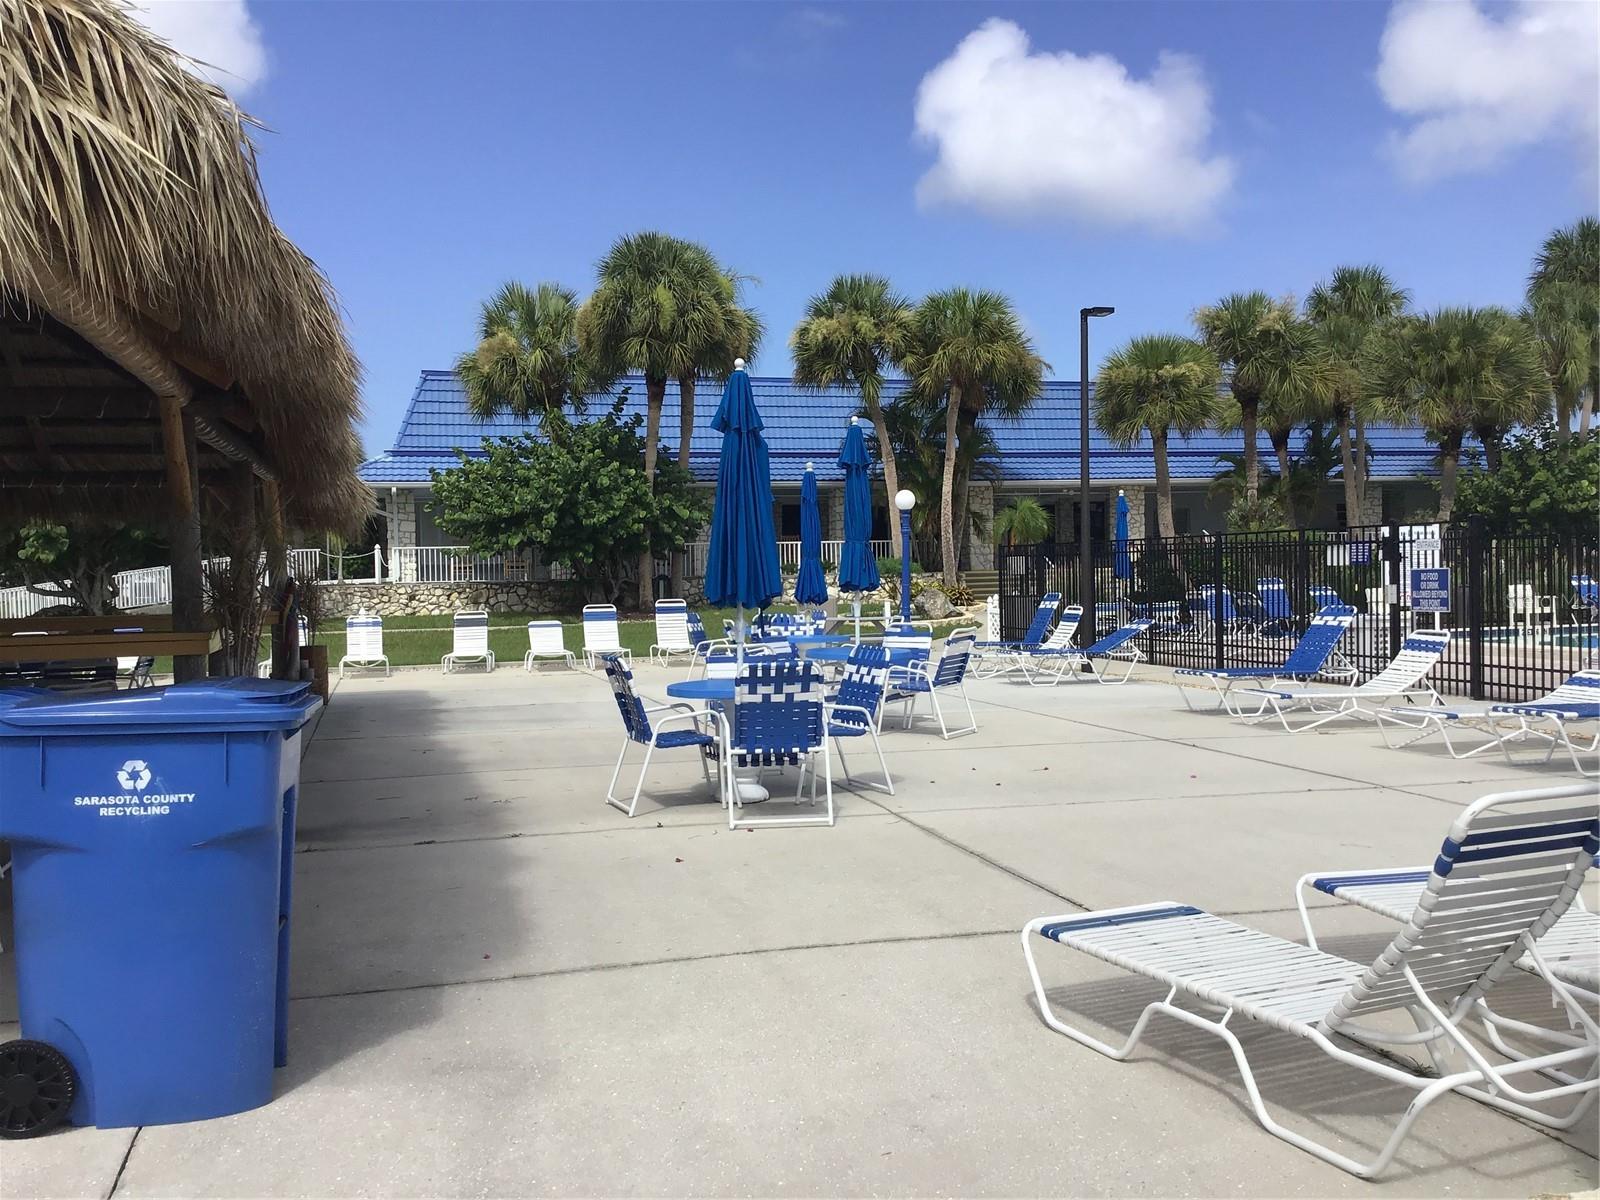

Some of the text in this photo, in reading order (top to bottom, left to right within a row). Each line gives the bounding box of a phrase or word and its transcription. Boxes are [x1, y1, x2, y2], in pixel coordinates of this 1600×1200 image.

[1416, 540, 1440, 549] ENTRANCE
[1427, 572, 1439, 580] FOOD
[1427, 581, 1440, 589] DRINK
[1412, 590, 1431, 598] ALLOWED
[1431, 590, 1448, 598] BEYOND
[1419, 599, 1441, 607] THIS POINT
[74, 794, 196, 805] SARASOTA COUNTY
[99, 806, 170, 816] RECYCLING
